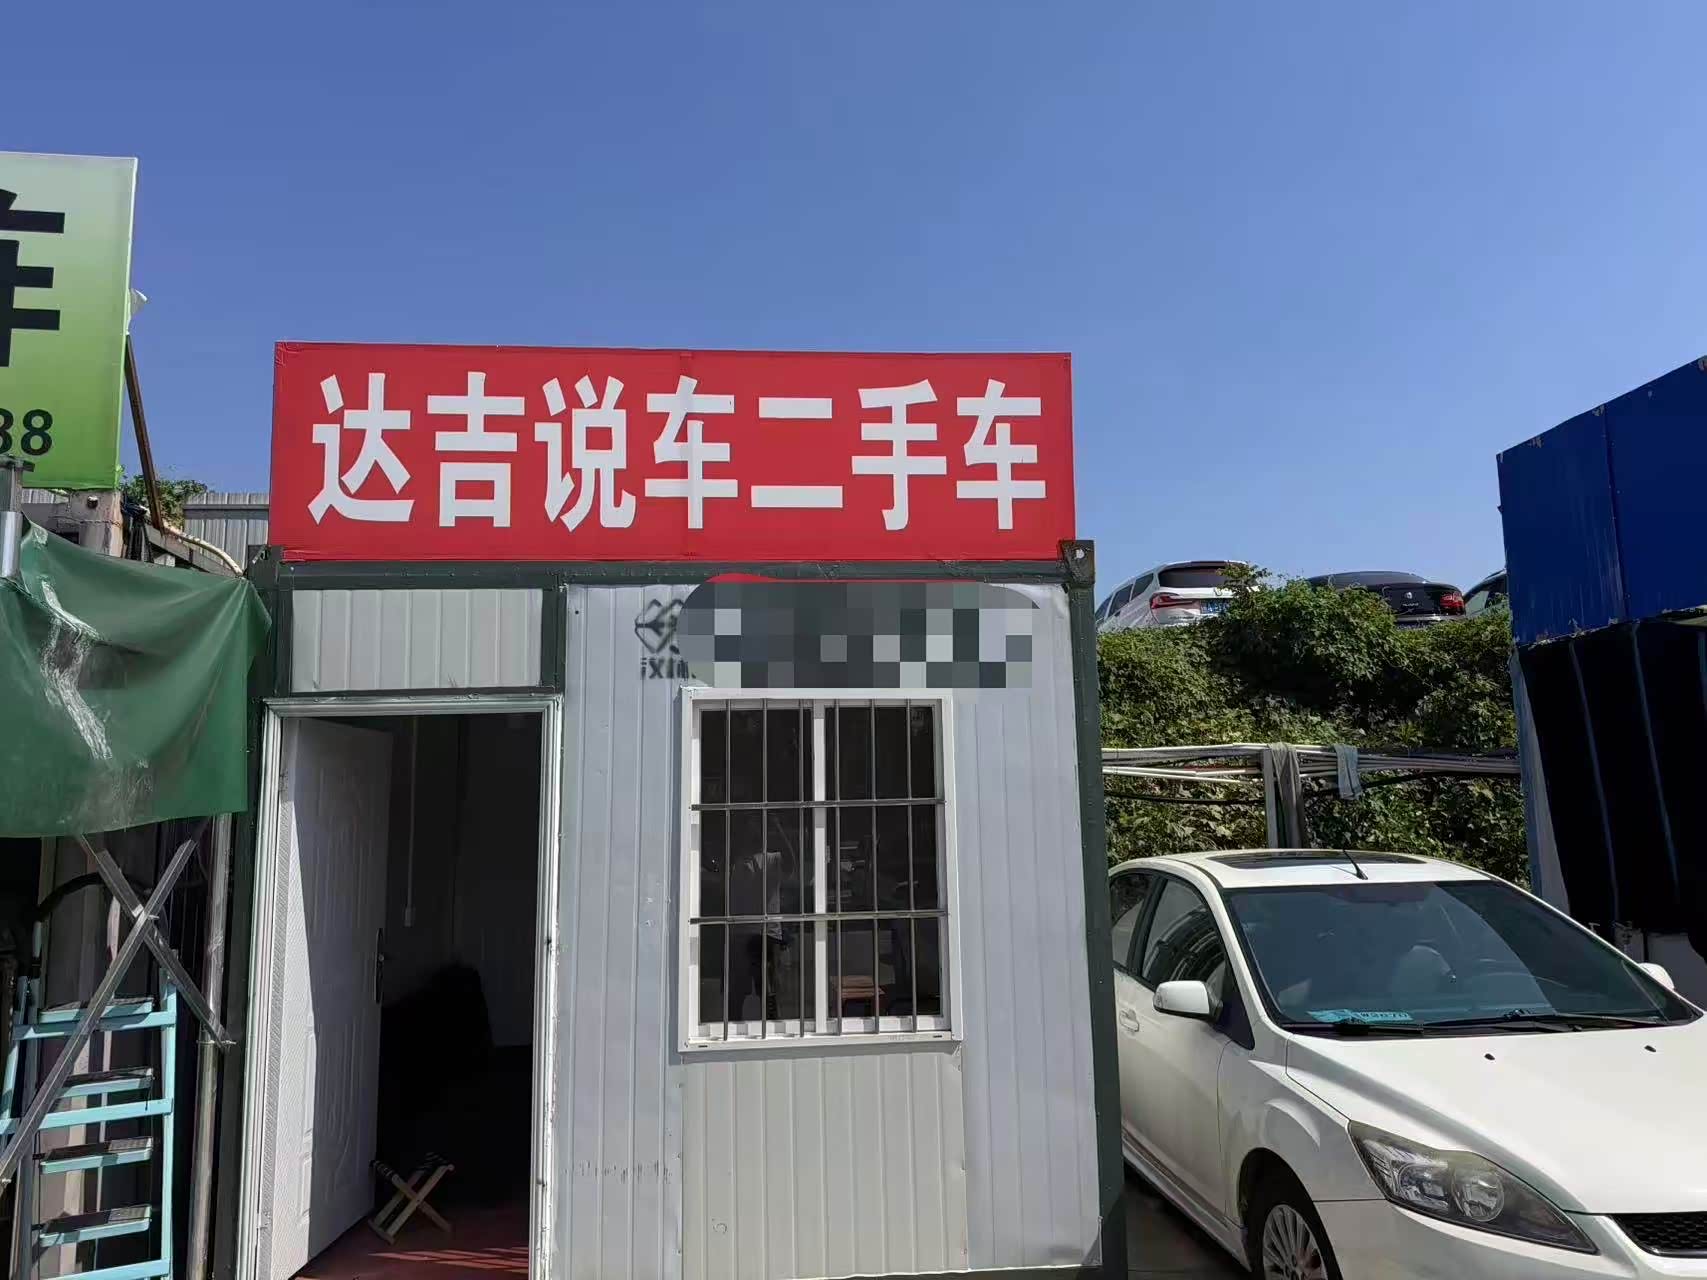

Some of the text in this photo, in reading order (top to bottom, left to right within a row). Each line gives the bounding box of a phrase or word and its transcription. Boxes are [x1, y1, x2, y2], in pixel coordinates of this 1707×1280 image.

[308, 372, 1046, 532] 达吉说车二手车
